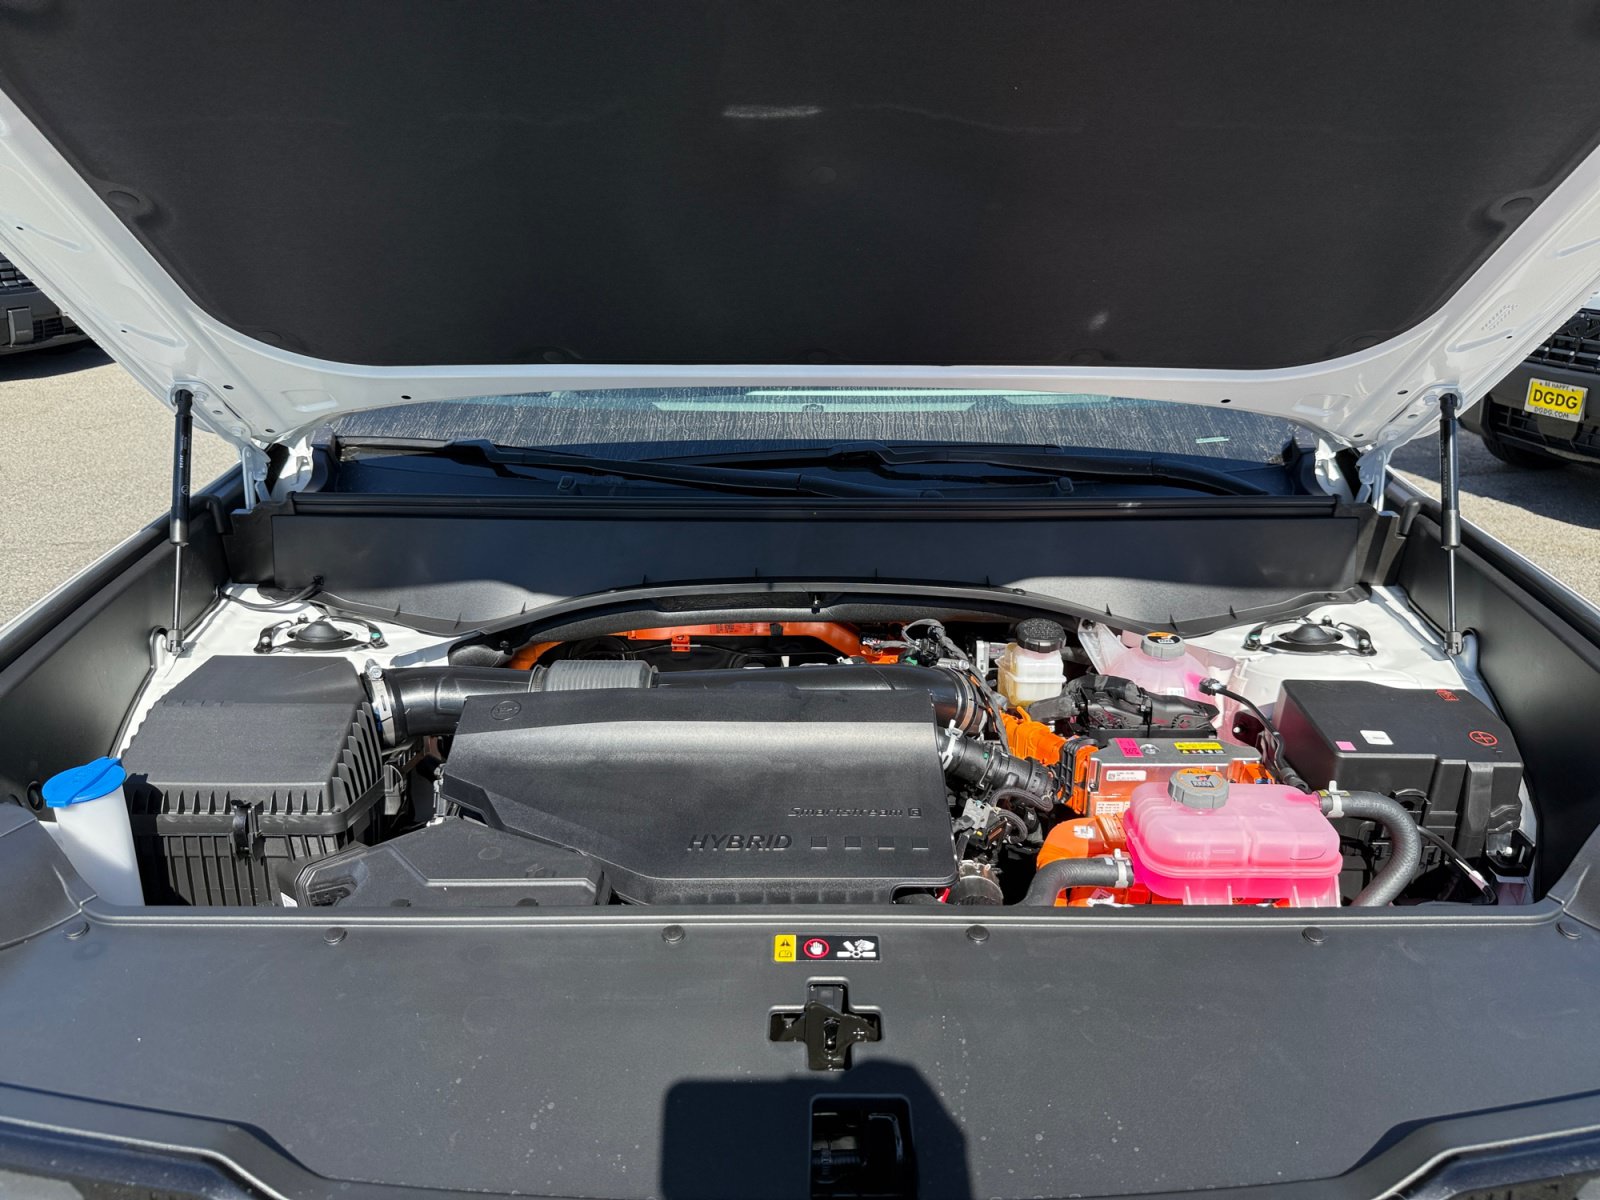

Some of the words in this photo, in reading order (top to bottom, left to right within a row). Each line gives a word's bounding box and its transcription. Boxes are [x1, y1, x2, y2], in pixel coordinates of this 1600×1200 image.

[1533, 389, 1578, 409] DGDG
[787, 807, 903, 818] Smartstream
[687, 834, 793, 851] HYBRID
